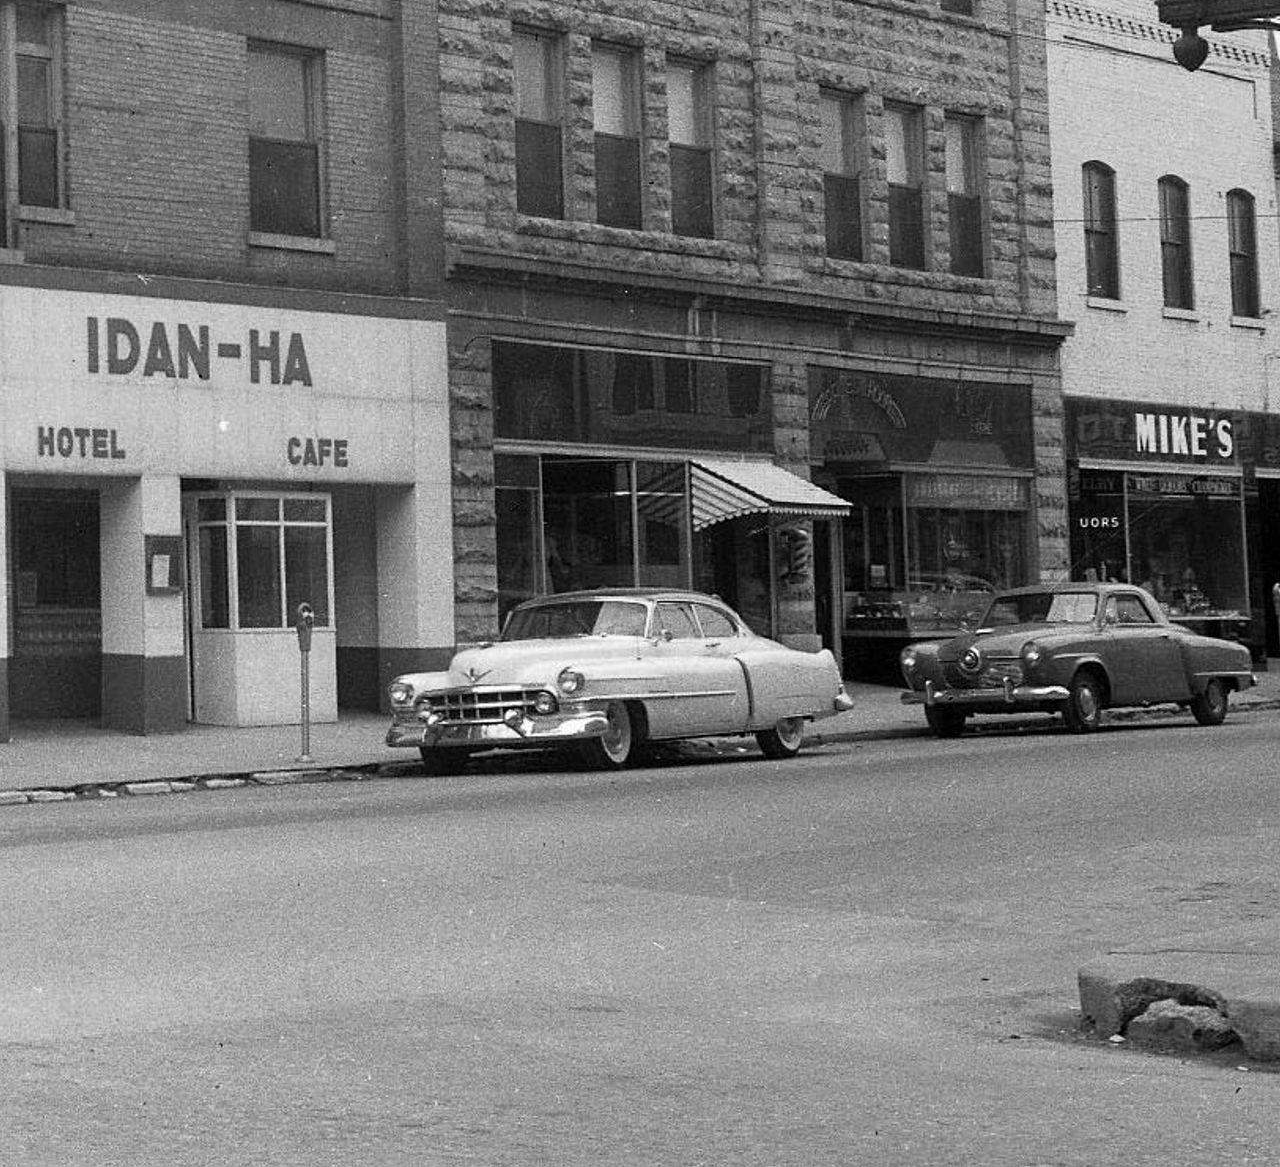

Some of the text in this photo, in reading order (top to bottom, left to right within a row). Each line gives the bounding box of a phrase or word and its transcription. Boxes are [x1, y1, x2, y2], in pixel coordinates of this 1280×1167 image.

[86, 316, 314, 387] IDAN-HA
[37, 425, 127, 460] HOTEL
[287, 436, 350, 468] CAFE
[1134, 412, 1234, 458] MIKE'S
